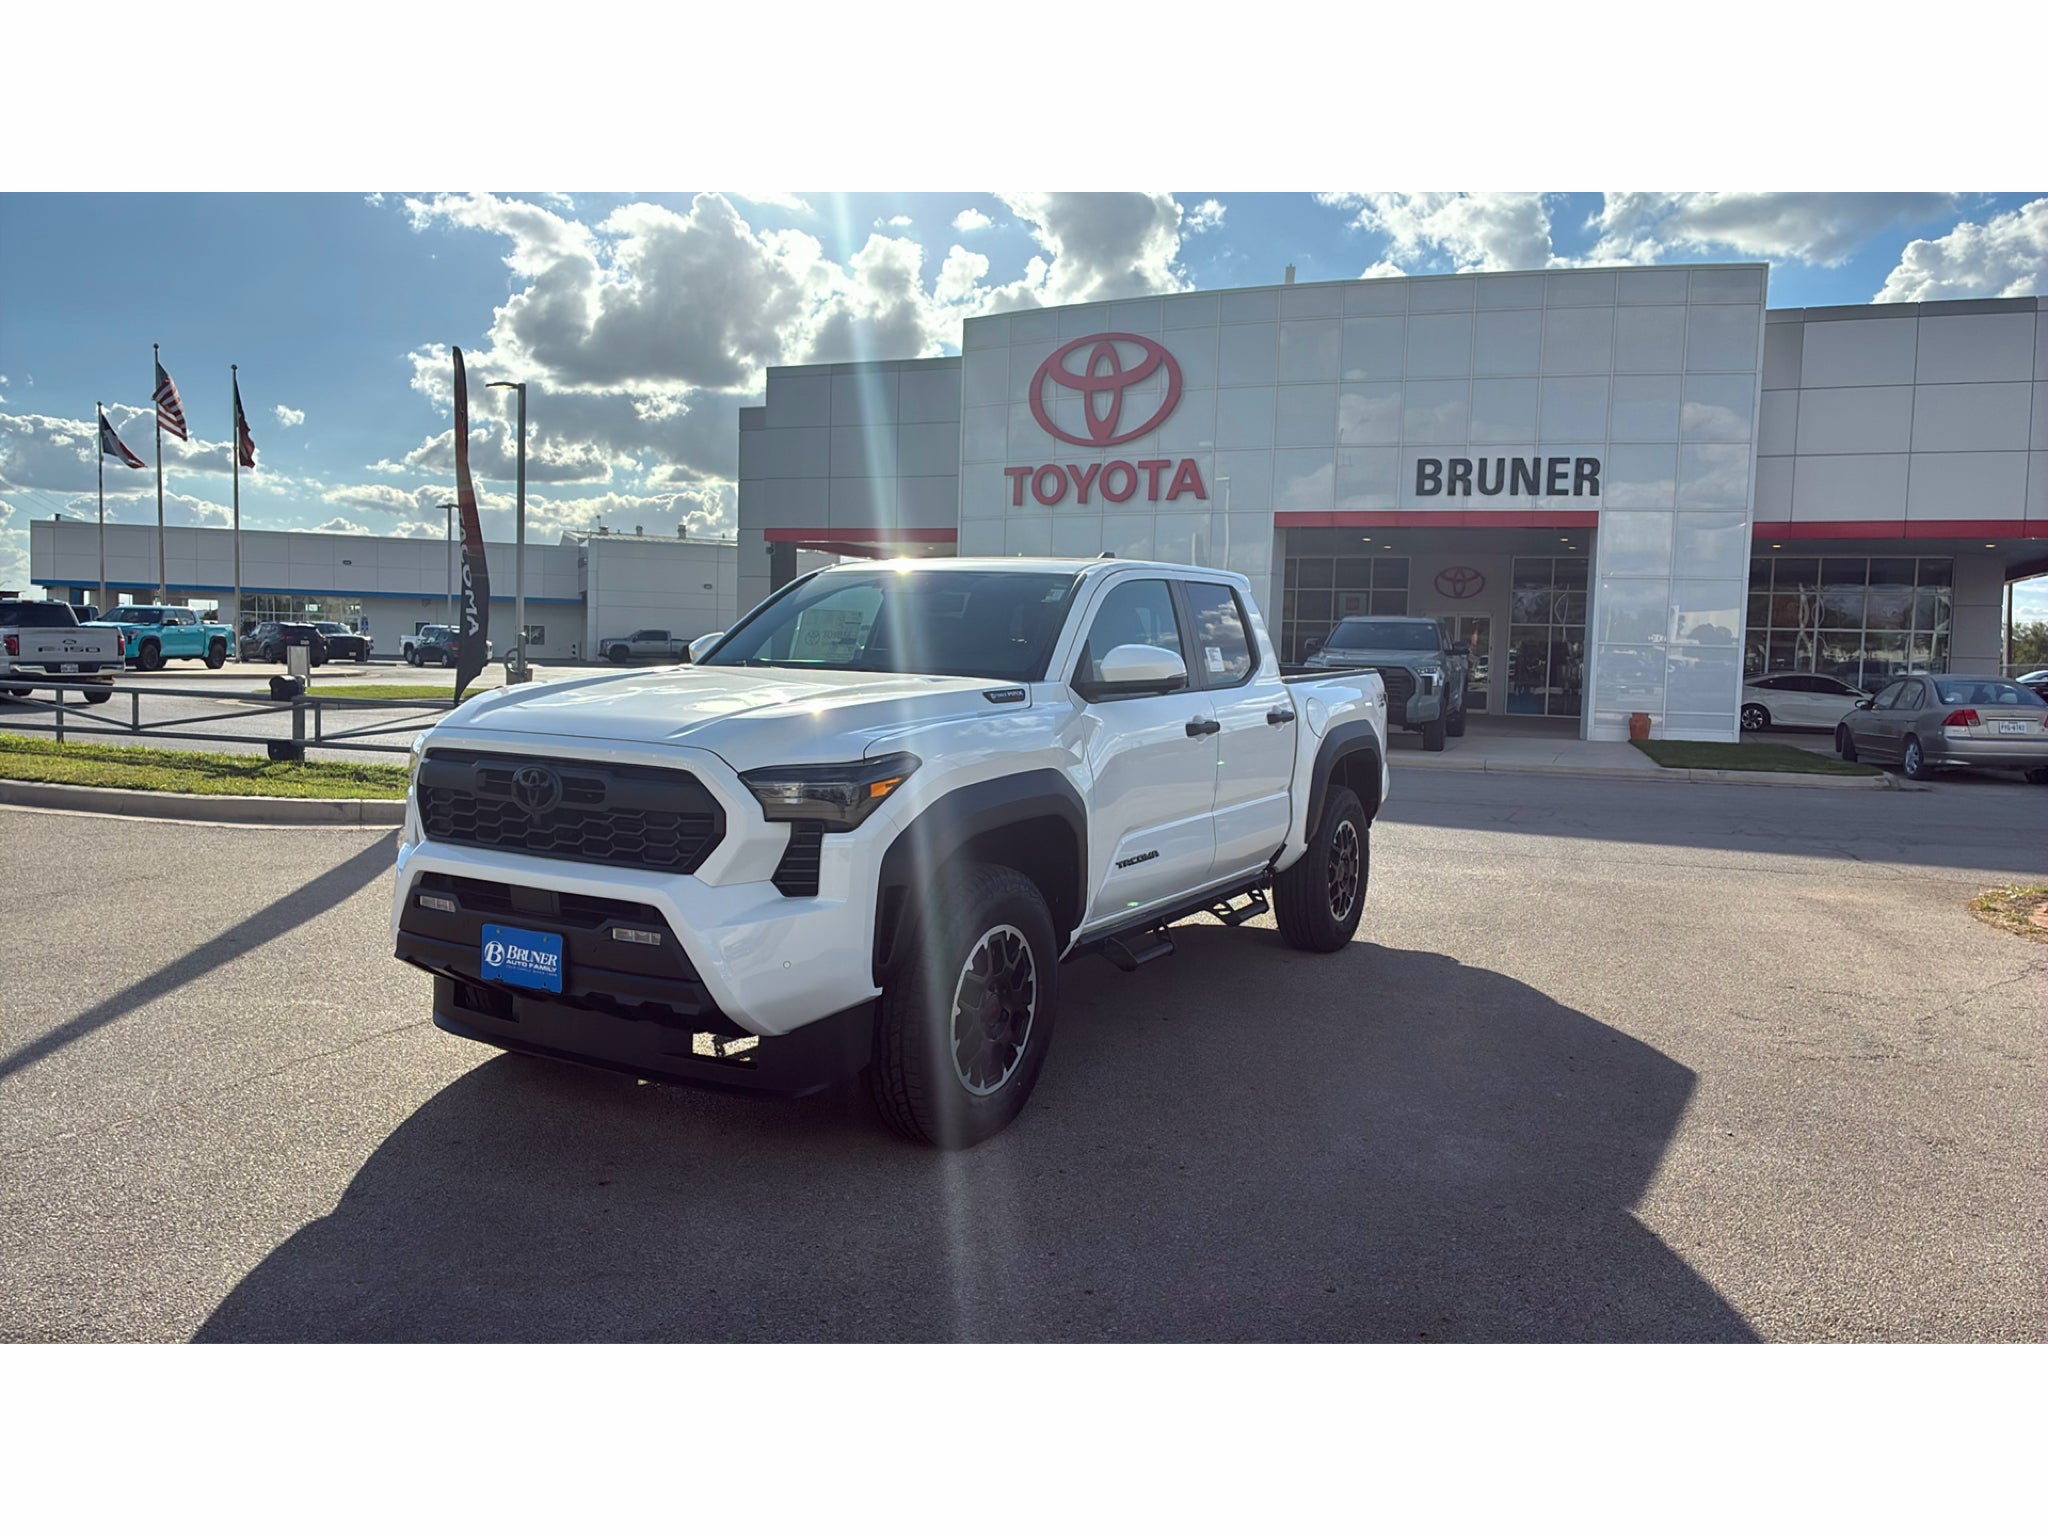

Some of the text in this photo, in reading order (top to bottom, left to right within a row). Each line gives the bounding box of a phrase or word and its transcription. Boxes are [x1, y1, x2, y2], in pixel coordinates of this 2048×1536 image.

[1004, 458, 1208, 506] TOYOTA
[1416, 457, 1600, 496] BRUNER
[1115, 850, 1160, 869] TACOMA
[506, 945, 558, 967] BRUNER
[506, 959, 528, 968] AUTO
[529, 963, 558, 973] FAMILY
